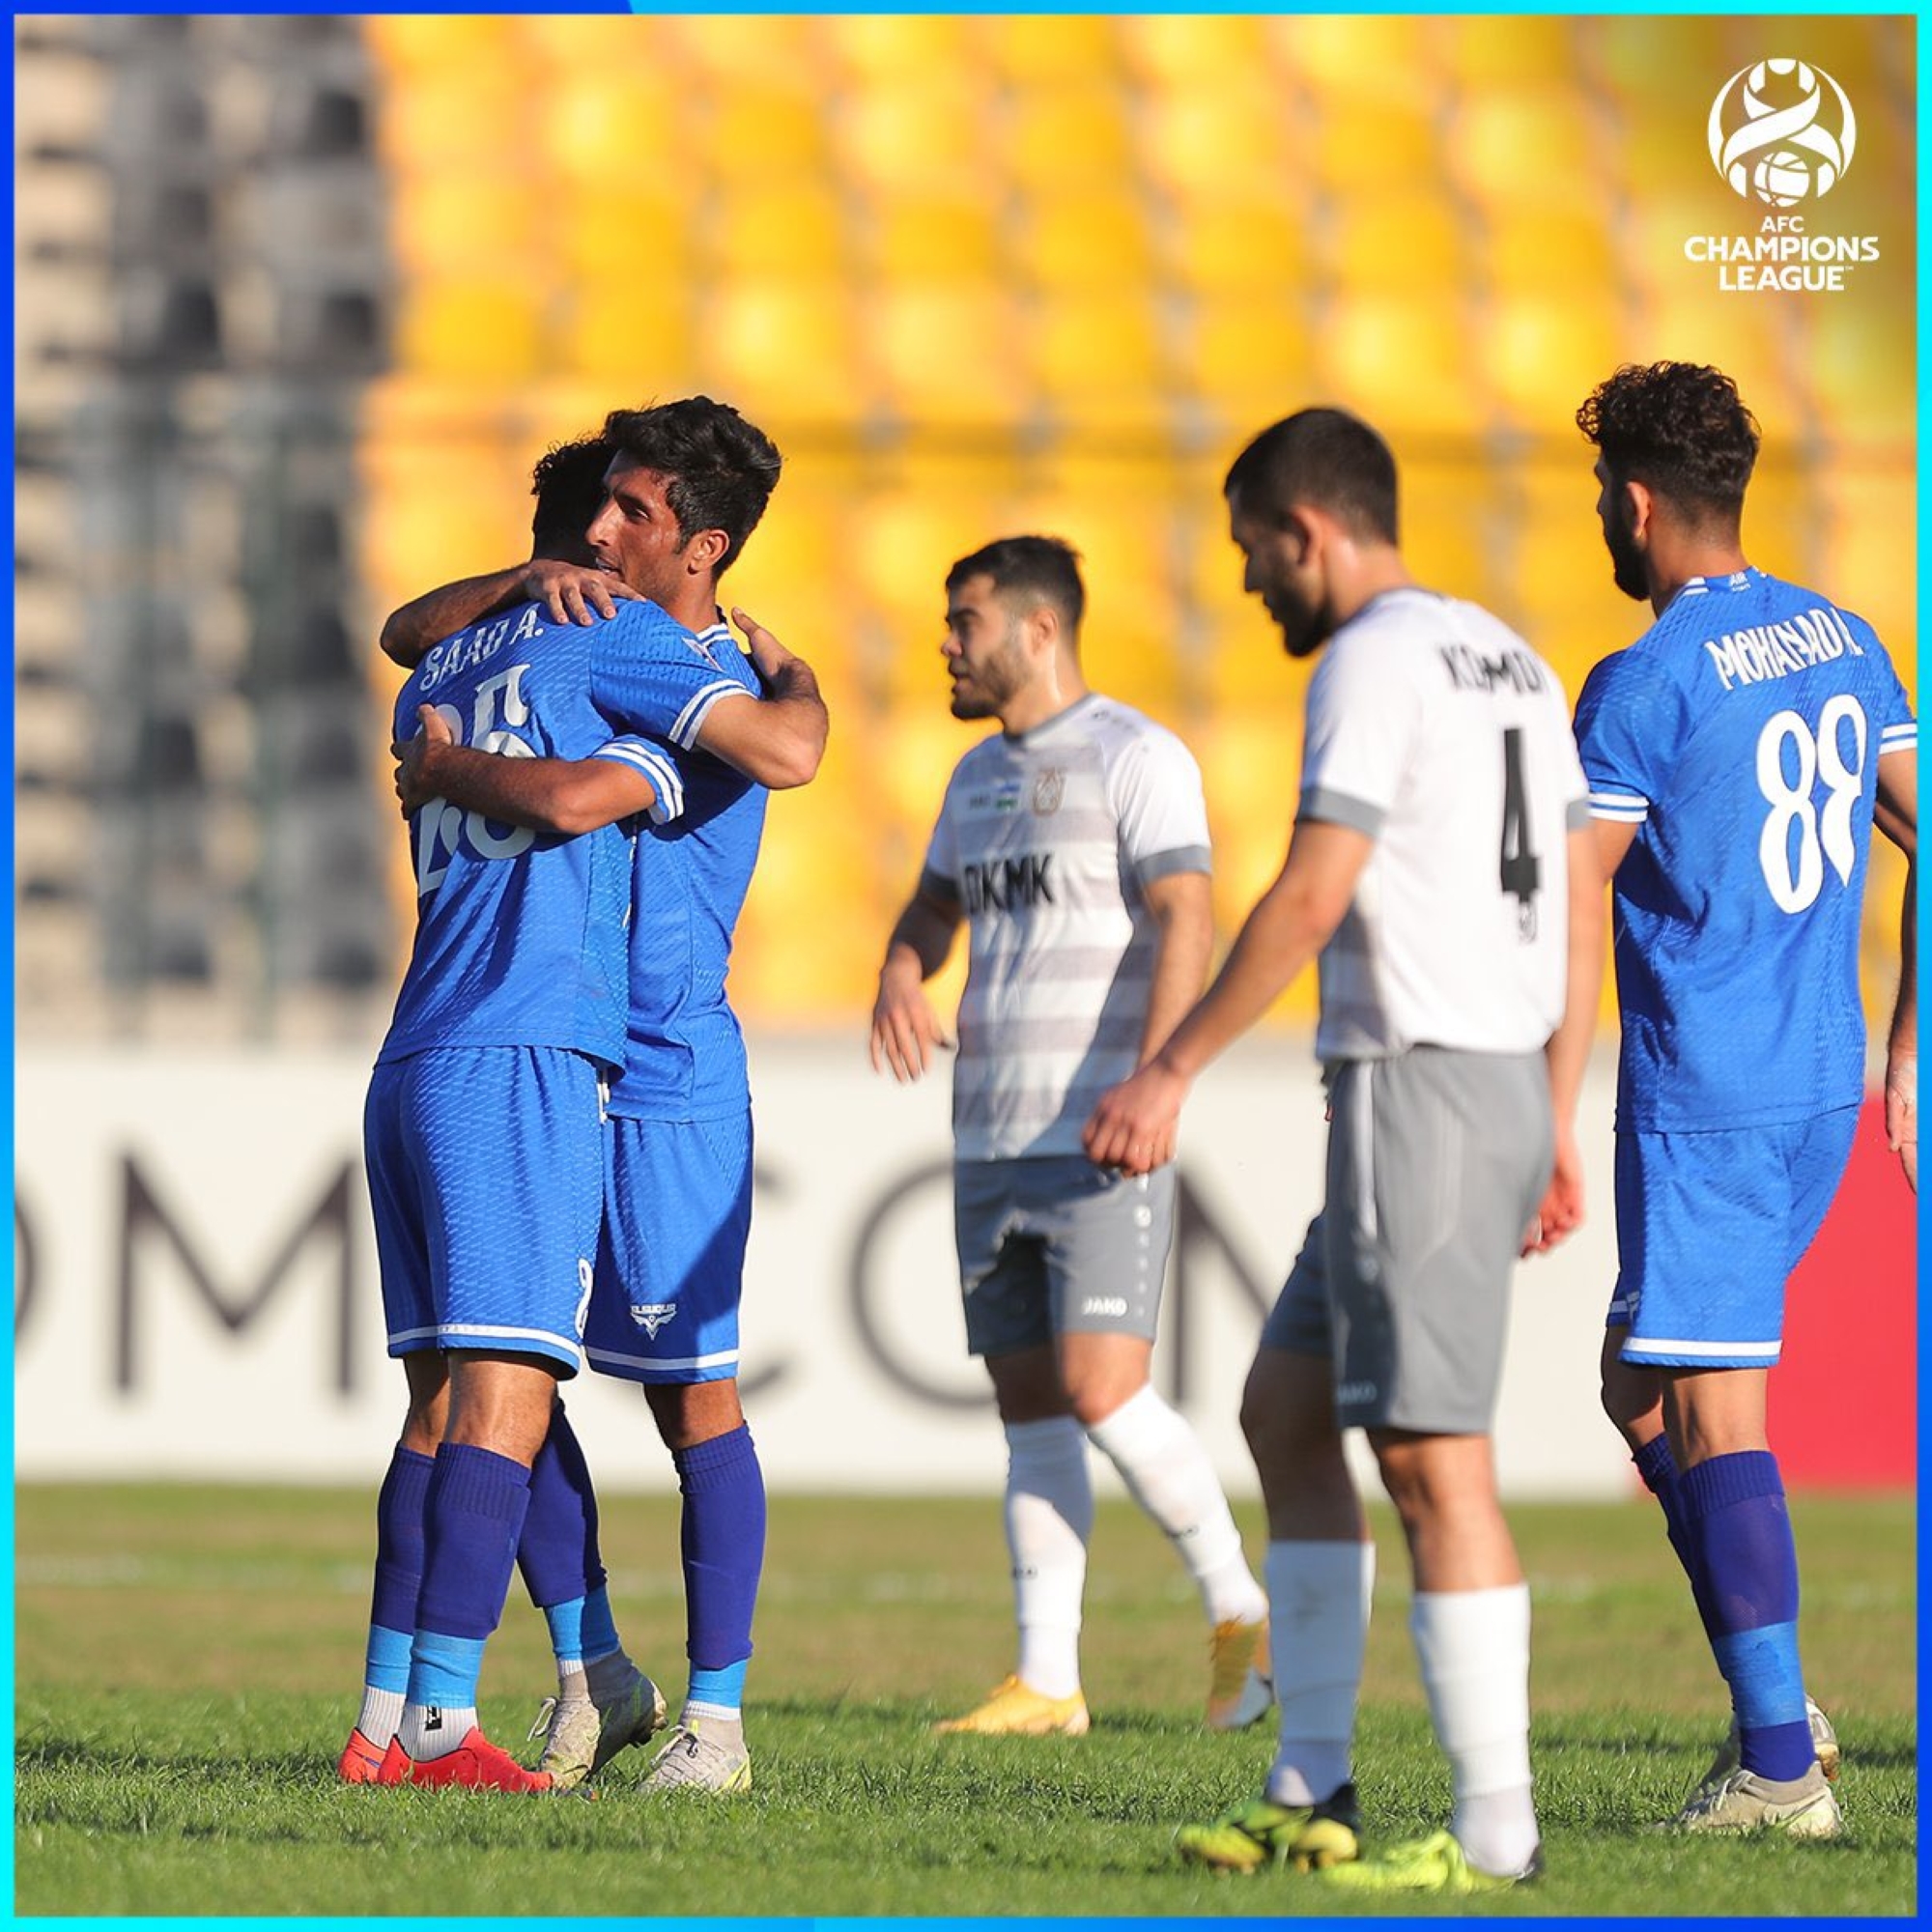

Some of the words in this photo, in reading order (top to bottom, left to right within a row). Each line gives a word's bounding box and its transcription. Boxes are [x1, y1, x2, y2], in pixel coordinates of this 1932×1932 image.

[420, 618, 510, 692] SAAD
[509, 602, 544, 645] A.
[1500, 727, 1541, 903] 4
[1082, 1296, 1127, 1316] JAKO
